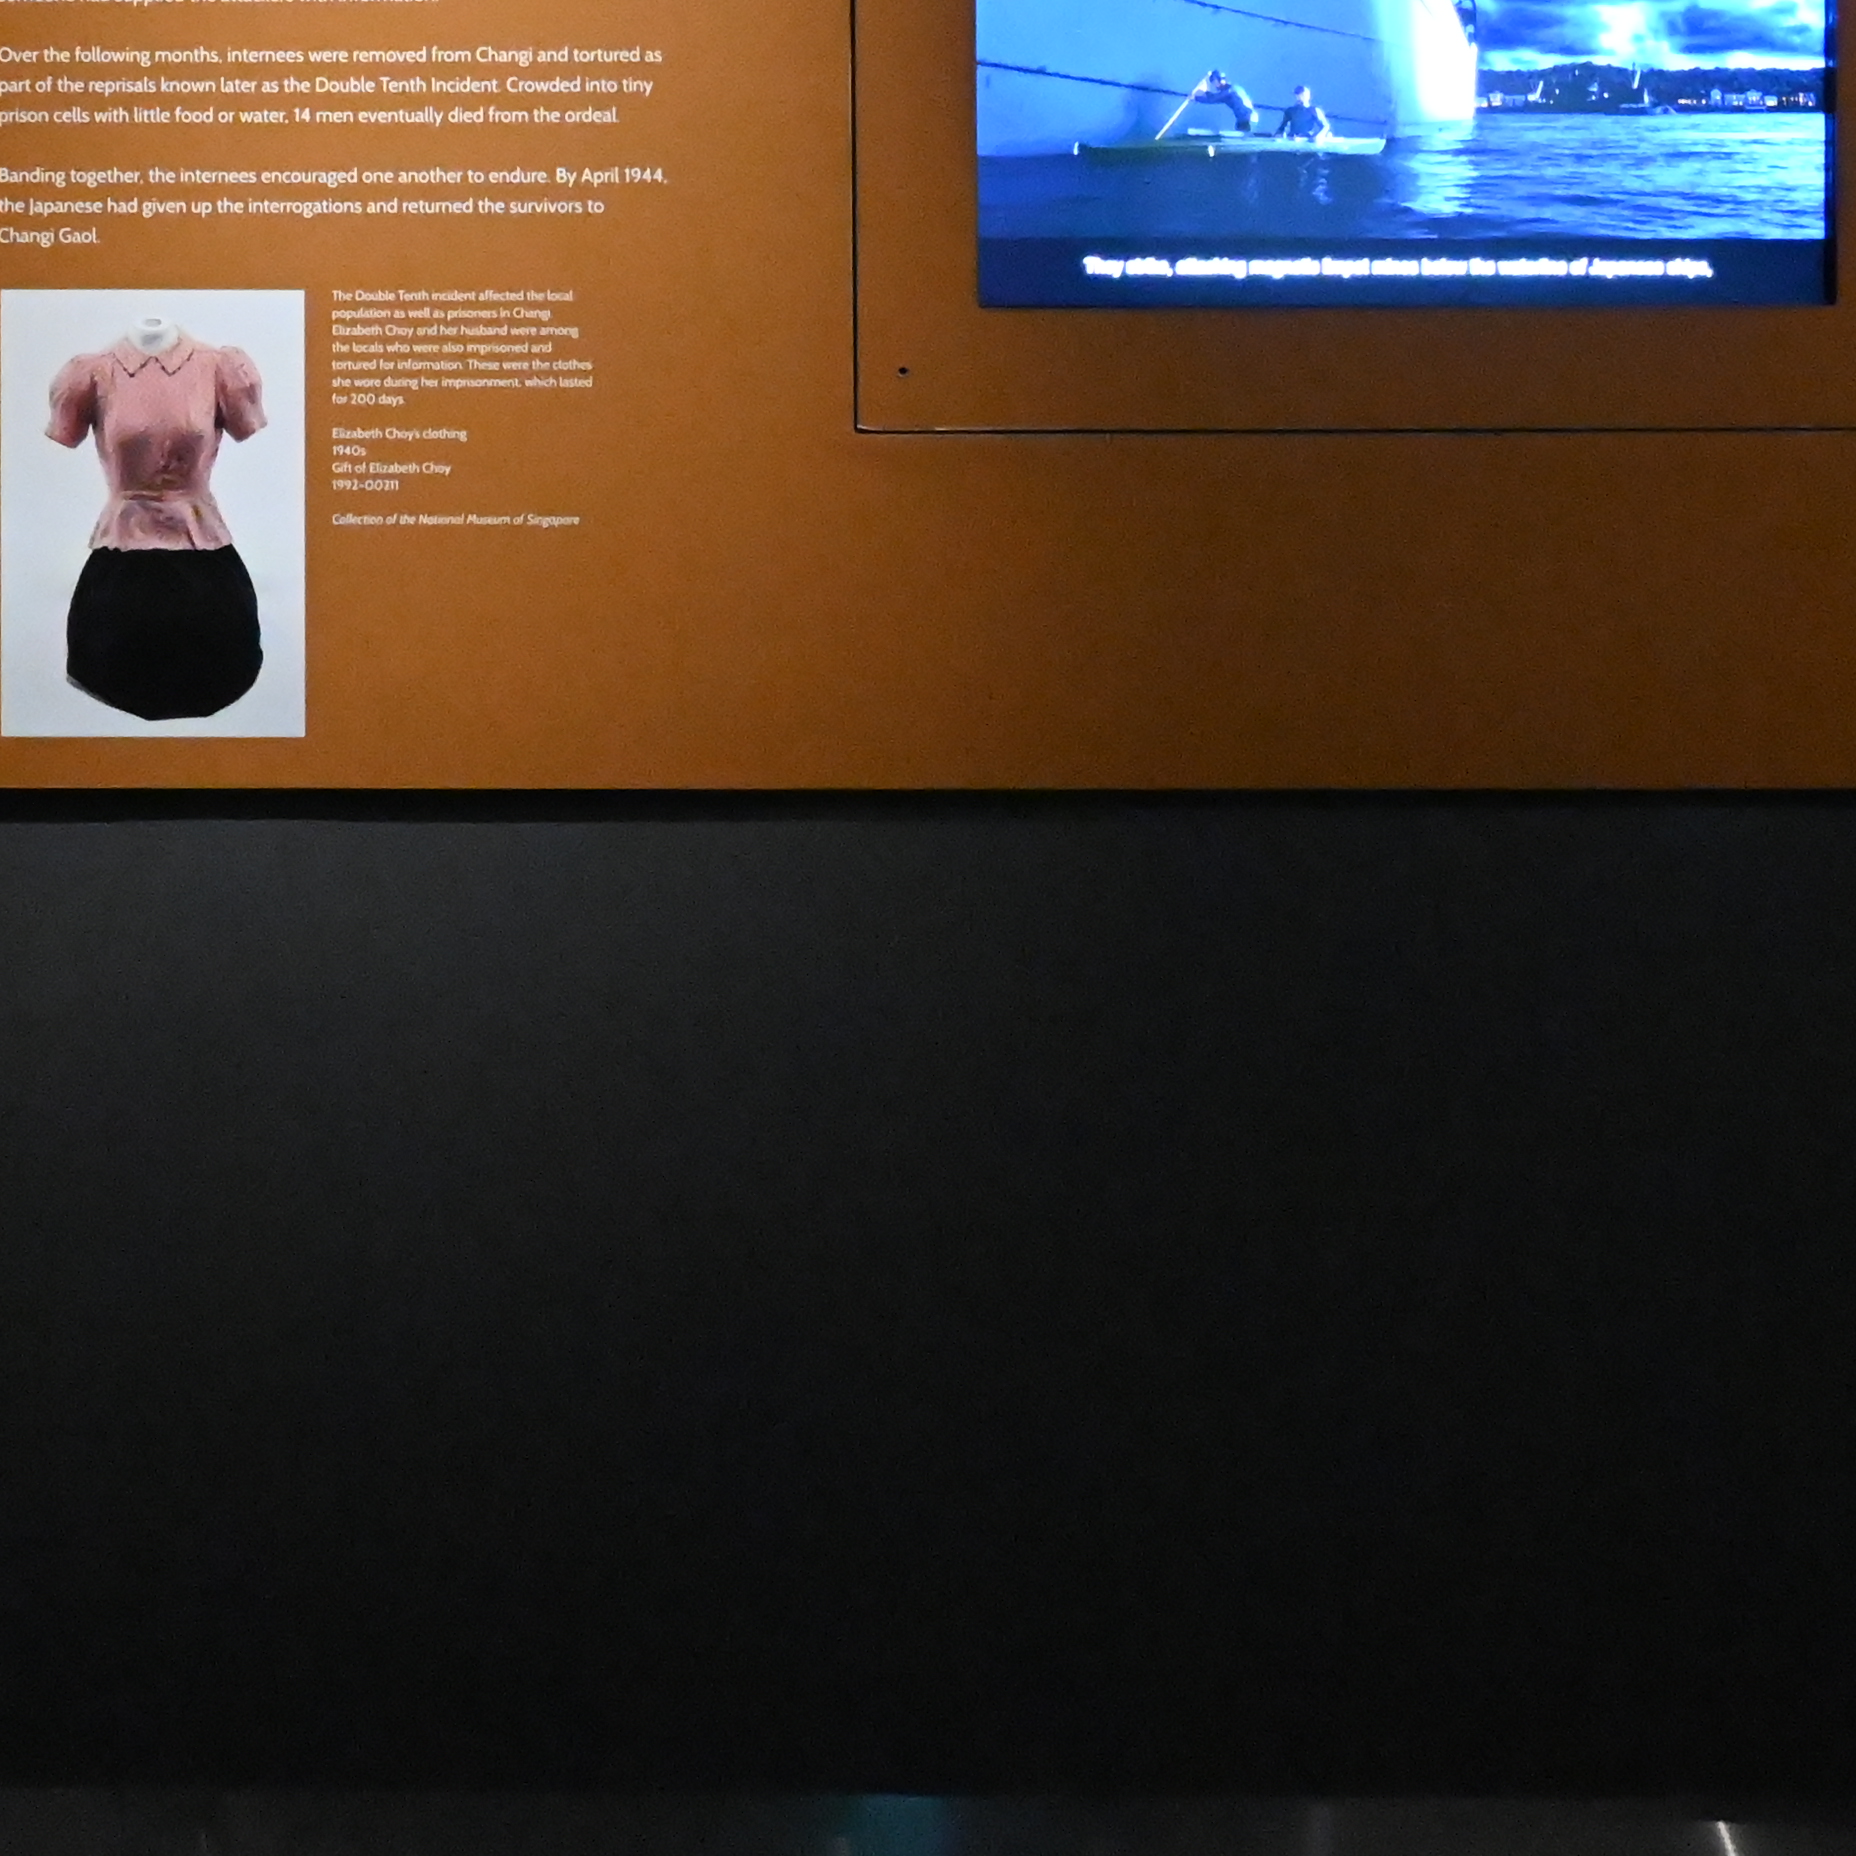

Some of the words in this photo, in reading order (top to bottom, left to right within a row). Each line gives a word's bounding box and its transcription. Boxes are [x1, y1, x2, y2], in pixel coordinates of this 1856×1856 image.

[43, 46, 70, 63] the
[75, 46, 151, 67] following
[155, 46, 222, 63] months,
[227, 47, 304, 63] internees
[308, 51, 348, 62] were
[353, 46, 426, 62] removed
[432, 46, 471, 62] from
[476, 46, 533, 67] Changi
[537, 46, 568, 62] and
[573, 46, 640, 62] tortured
[645, 50, 662, 62] as
[35, 76, 52, 93] of
[57, 75, 84, 92] the
[89, 76, 156, 97] reprisals
[161, 76, 216, 93] known
[221, 77, 257, 93] later
[261, 81, 279, 93] as
[283, 76, 311, 93] the
[316, 75, 375, 93] Double
[379, 76, 426, 93] Tenth
[432, 76, 500, 93] Incident.
[506, 75, 581, 93] Crowded
[586, 77, 617, 93] into
[622, 77, 653, 97] tiny
[53, 106, 90, 123] cells
[94, 107, 129, 123] with
[134, 107, 170, 123] little
[174, 106, 213, 123] food
[218, 111, 235, 123] or
[239, 109, 288, 123] water,
[294, 107, 310, 122] 14
[316, 111, 353, 123] men
[358, 106, 443, 127] eventually
[448, 106, 483, 123] died
[488, 106, 529, 123] from
[533, 106, 560, 122] the
[565, 106, 619, 123] ordeal.
[70, 167, 143, 188] together,
[149, 167, 176, 183] the
[180, 168, 257, 183] internees
[261, 167, 357, 188] encouraged
[362, 172, 394, 183] one
[398, 167, 463, 183] another
[467, 170, 484, 183] to
[489, 166, 550, 183] endure.
[556, 167, 577, 187] By
[581, 167, 619, 187] April
[624, 167, 667, 184] 1944,
[29, 198, 103, 217] Japanese
[107, 197, 138, 213] had
[142, 198, 186, 218] given
[191, 201, 212, 218] up
[217, 197, 244, 213] the
[249, 198, 362, 218] interrogations
[367, 197, 398, 213] and
[402, 197, 473, 213] returned
[478, 197, 505, 213] the
[509, 198, 583, 214] survivors
[587, 200, 604, 213] to
[59, 227, 100, 243] Gaol.
[332, 290, 353, 301] The
[355, 290, 395, 301] Double
[398, 290, 429, 301] Tenth
[432, 290, 476, 301] incident
[478, 290, 524, 301] affected
[526, 290, 545, 301] the
[547, 289, 573, 301] local
[332, 427, 383, 439] Elizabeth
[422, 428, 467, 442] clothing
[333, 445, 366, 456] 1940s
[332, 461, 352, 473] Gift
[354, 462, 366, 473] of
[369, 462, 420, 473] Elizabeth
[422, 461, 451, 476] Choy
[332, 513, 383, 525] Collection
[385, 513, 397, 525] of
[399, 514, 416, 525] the
[418, 513, 464, 525] National
[466, 514, 511, 525] Museum
[513, 514, 525, 525] of
[527, 514, 580, 528] Singapore
